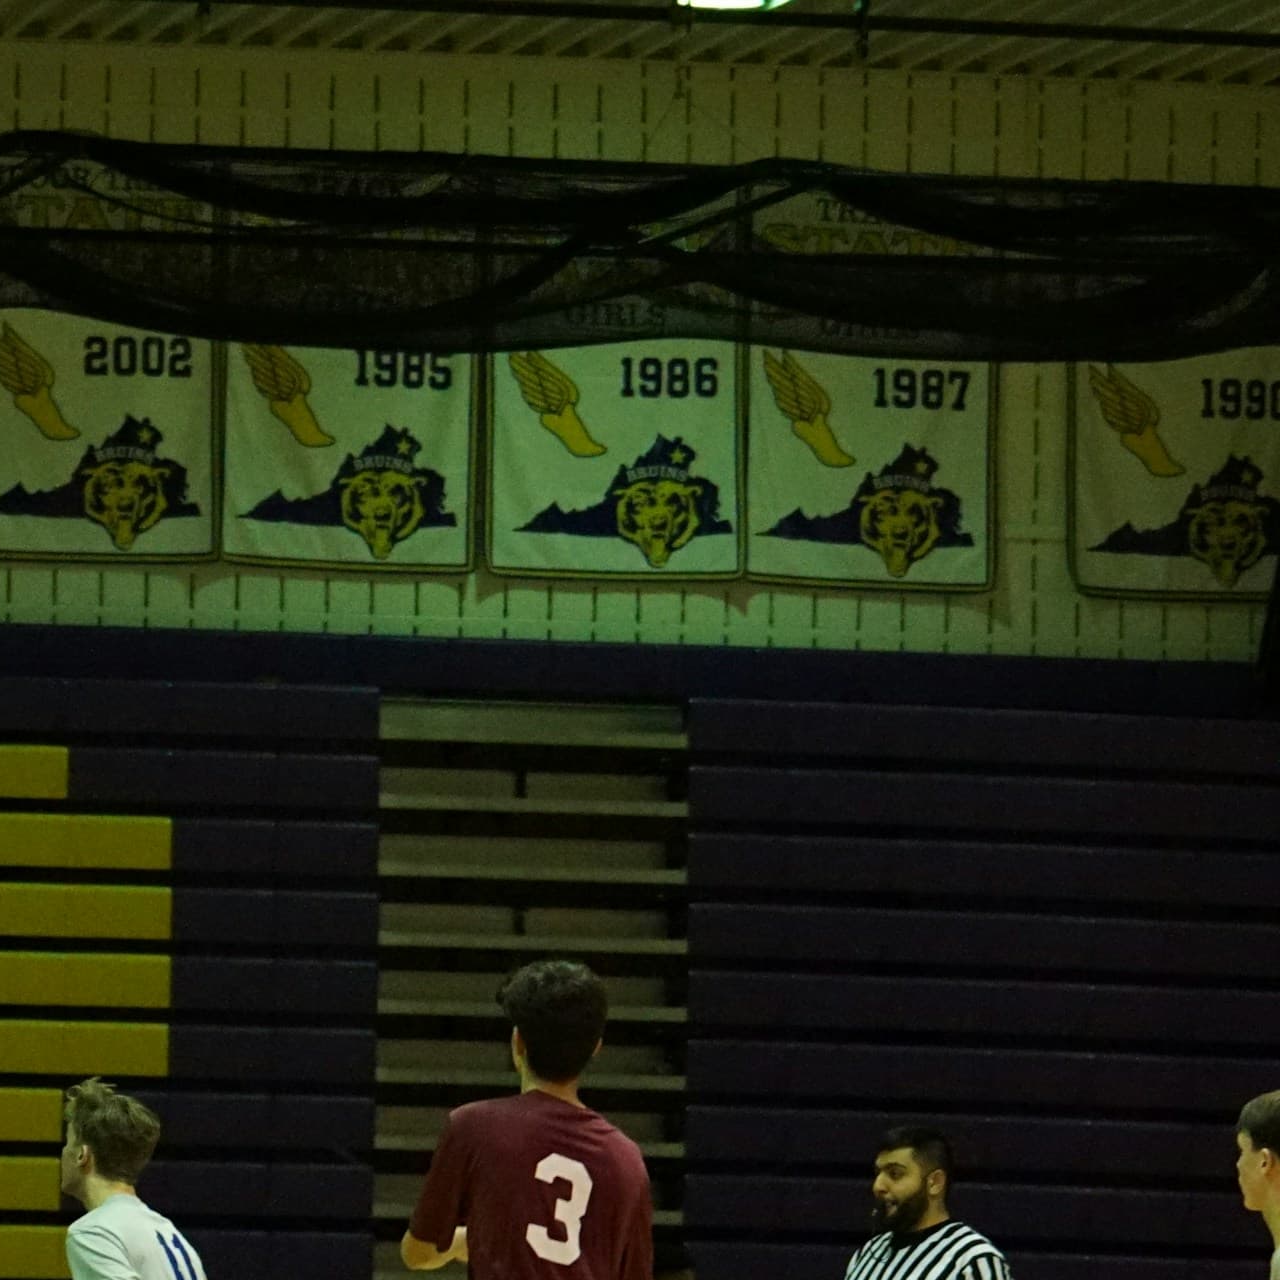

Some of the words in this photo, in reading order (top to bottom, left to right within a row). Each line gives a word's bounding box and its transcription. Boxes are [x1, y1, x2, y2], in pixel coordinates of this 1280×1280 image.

[84, 336, 193, 378] 2002
[354, 351, 453, 391] 1985
[621, 357, 719, 399] 1986
[873, 368, 970, 411] 1987
[525, 1152, 593, 1266] 3
